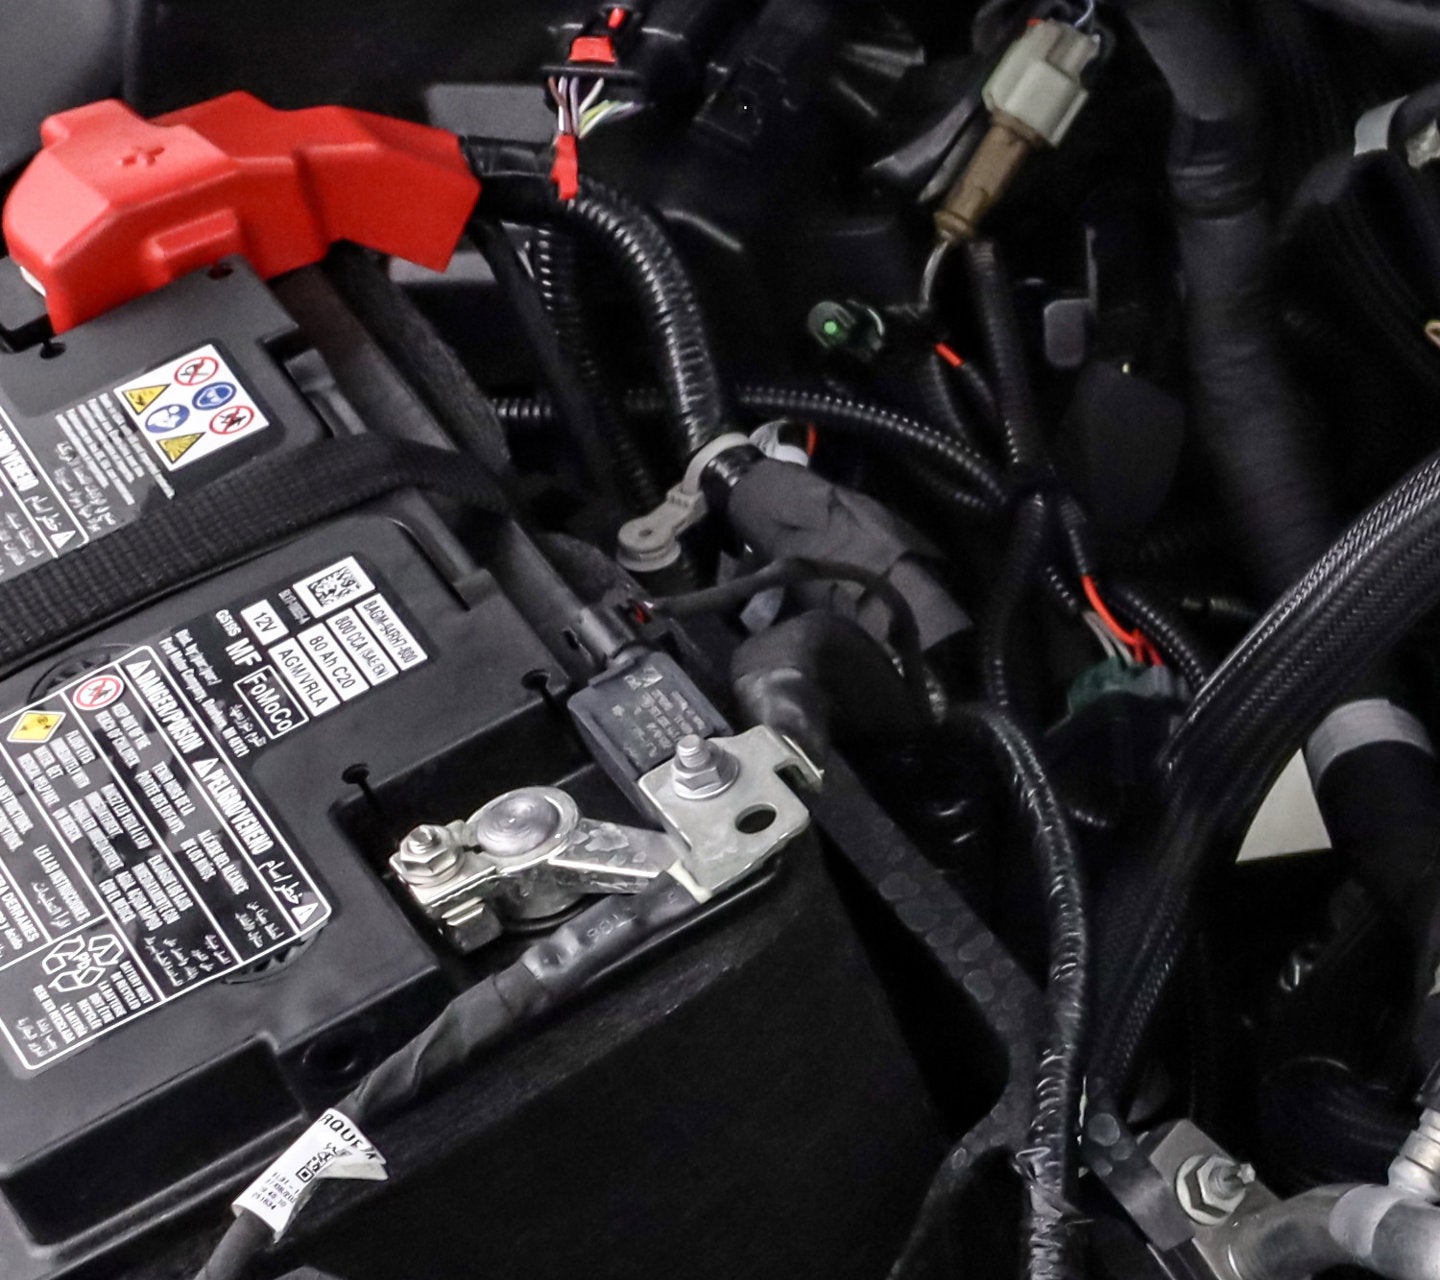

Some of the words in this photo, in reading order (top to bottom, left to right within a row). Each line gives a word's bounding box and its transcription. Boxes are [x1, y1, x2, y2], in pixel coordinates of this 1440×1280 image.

[254, 611, 276, 633] 12V
[347, 631, 367, 650] CCA
[225, 637, 261, 670] MF
[278, 647, 327, 707] AGM/VRLA
[309, 635, 327, 651] 80
[320, 650, 338, 667] Ah
[332, 665, 354, 689] C20
[133, 669, 203, 754] DANGER/POISON
[244, 672, 296, 732] FoMoCo
[201, 768, 274, 856] PELIGRO/VENENO
[0, 892, 40, 942] DERRAMES
